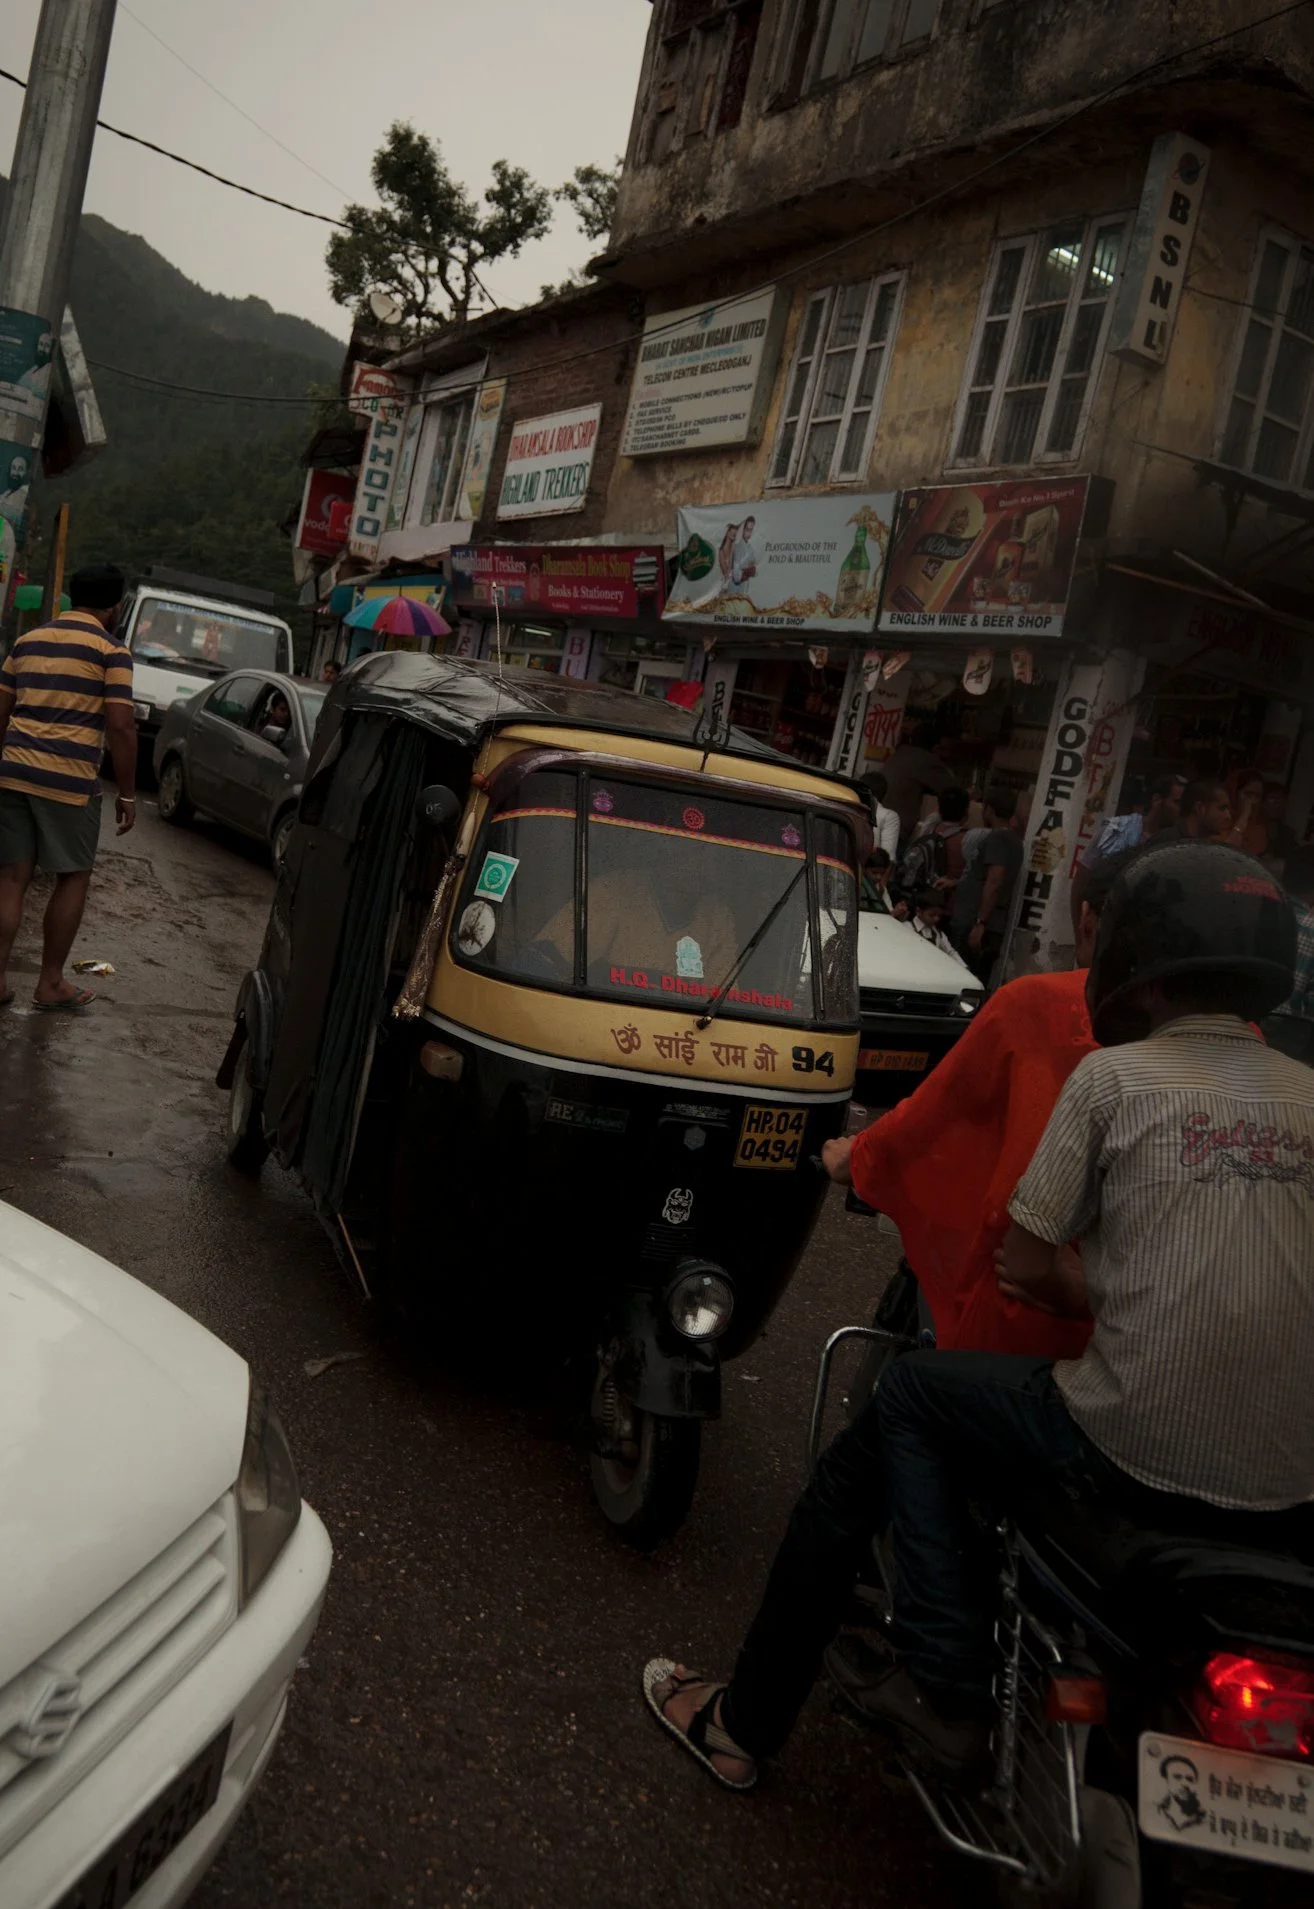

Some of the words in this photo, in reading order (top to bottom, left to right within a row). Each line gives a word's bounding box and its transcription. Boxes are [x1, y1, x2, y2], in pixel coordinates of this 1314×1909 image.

[1143, 190, 1190, 350] BSNL
[705, 327, 733, 348] NIGAM
[732, 318, 767, 342] LIMITED
[643, 371, 672, 386] TELECOM
[673, 366, 699, 380] CENTRE
[729, 412, 746, 421] ONLY
[356, 420, 397, 538] PHOTO
[812, 542, 822, 552] OF
[823, 541, 838, 552] THE
[494, 555, 527, 574] Trekkers
[587, 553, 608, 577] Book
[609, 552, 631, 584] Shop
[768, 554, 788, 565] BOLD
[795, 554, 833, 564] BEAUTIFUL
[548, 584, 572, 598] Books
[573, 585, 580, 598] &
[580, 586, 625, 604] Stationery
[713, 615, 741, 624] ENGLISH
[741, 616, 758, 624] WINE
[766, 616, 785, 625] BEER
[786, 617, 805, 626] SHOP
[889, 613, 935, 626] ENGLISH
[938, 614, 967, 627] WINE
[970, 615, 979, 627] &
[982, 614, 1014, 628] BEER
[1017, 615, 1052, 629] SHOP
[610, 967, 654, 989] H.Q.
[710, 1041, 748, 1069] राम
[753, 1043, 779, 1073] जी
[792, 1046, 835, 1078] 94
[741, 1138, 799, 1163] 0494
